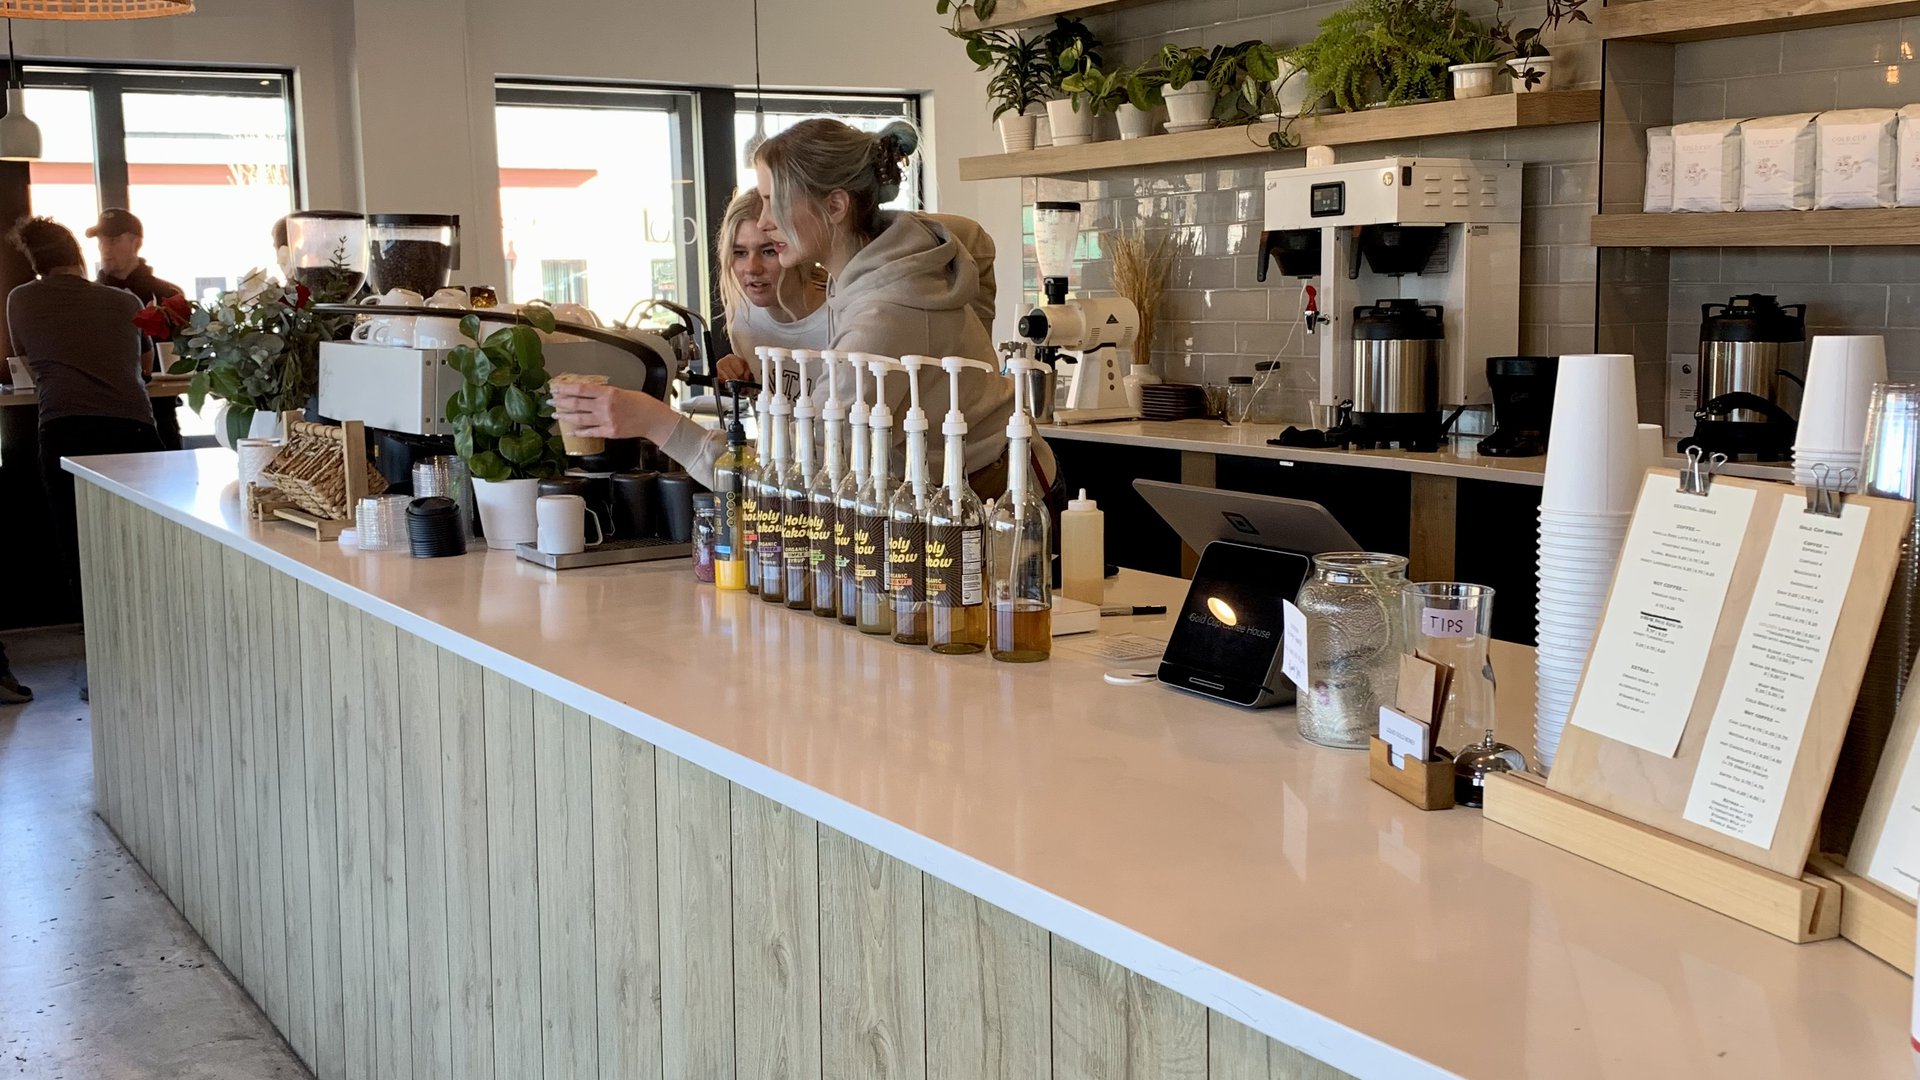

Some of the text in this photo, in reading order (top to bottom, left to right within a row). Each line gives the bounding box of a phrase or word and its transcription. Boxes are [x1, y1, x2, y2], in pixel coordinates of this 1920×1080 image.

[784, 514, 808, 528] Holy
[1188, 612, 1206, 624] Gold
[1246, 626, 1271, 638] House
[1430, 616, 1464, 633] TIPS
